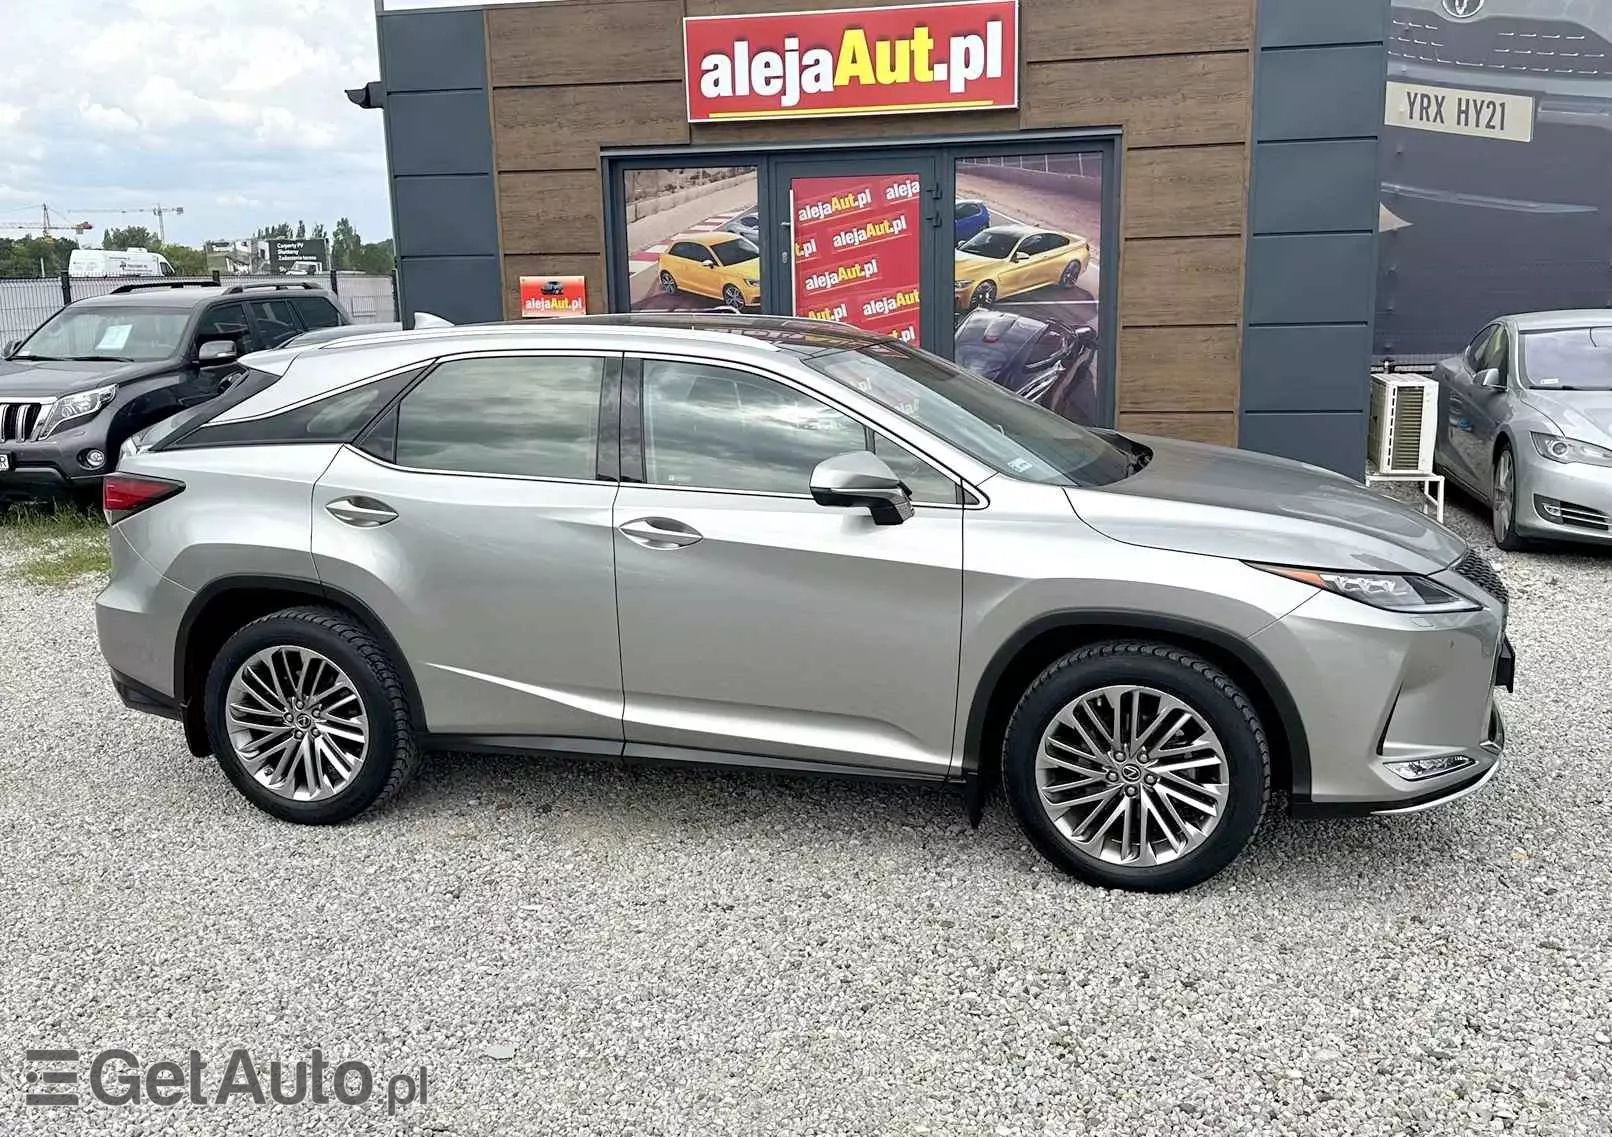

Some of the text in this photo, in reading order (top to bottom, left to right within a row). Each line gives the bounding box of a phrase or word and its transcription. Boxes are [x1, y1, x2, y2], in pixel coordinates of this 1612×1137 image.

[700, 20, 1002, 107] alejaAut.pl
[1406, 91, 1506, 131] YRX HY21
[798, 189, 872, 222] alejaAut.pl
[885, 180, 920, 200] aleja
[832, 215, 907, 247] alejaAut.pl
[805, 259, 878, 290] alejaAut.pl
[525, 297, 582, 311] alejaAut.pl
